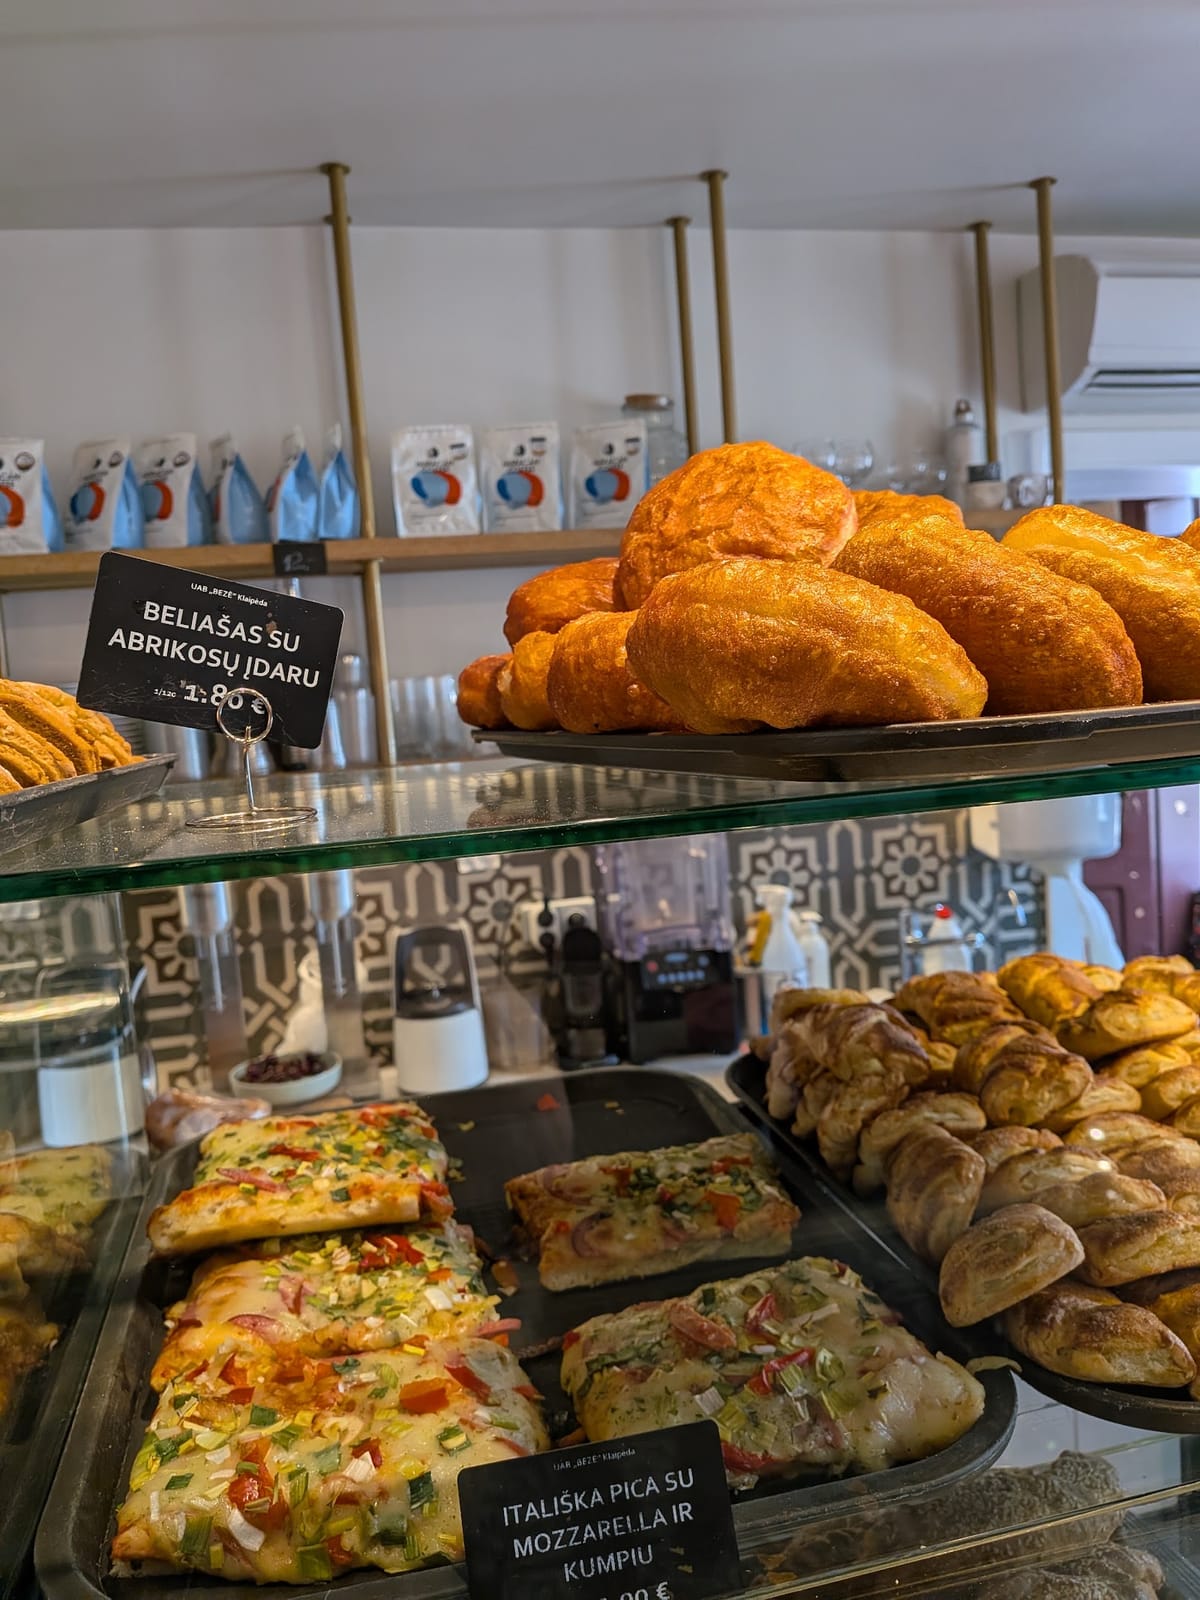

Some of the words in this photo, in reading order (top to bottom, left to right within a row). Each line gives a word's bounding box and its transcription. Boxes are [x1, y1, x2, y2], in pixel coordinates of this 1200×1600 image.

[190, 582, 208, 593] UAB
[237, 593, 268, 608] Klaipėda
[143, 600, 264, 645] BELIAŠAS
[267, 630, 301, 653] SU
[108, 628, 240, 677] ABRIKOSŲ
[242, 655, 320, 689] ĮDARU
[183, 683, 244, 710] 1.80
[250, 696, 267, 715] €
[553, 1460, 571, 1471] UAB
[503, 1486, 605, 1527] ITALIŠKA
[609, 1476, 660, 1504] PICA
[664, 1467, 695, 1493] SU
[513, 1507, 667, 1559] MOZZARELLA
[671, 1502, 694, 1524] IR
[563, 1544, 653, 1583] KUMPIU
